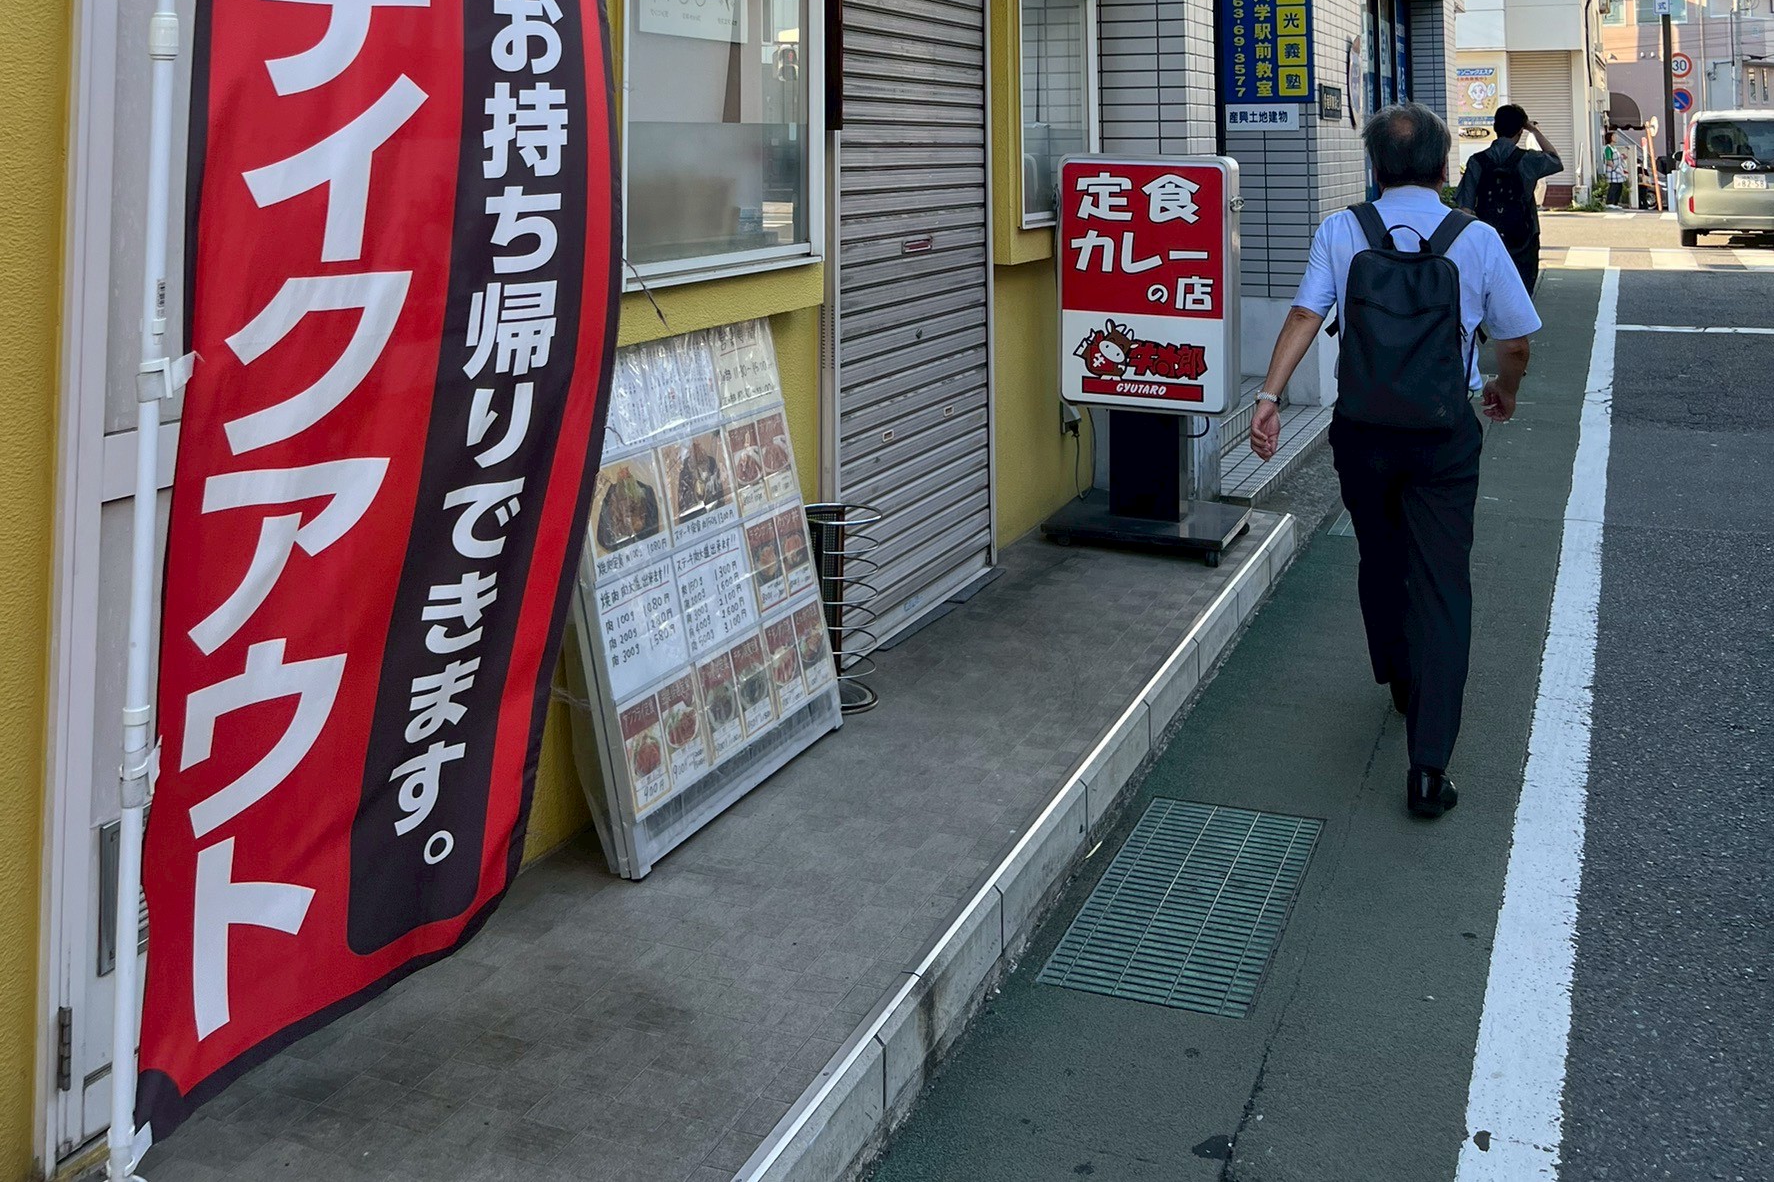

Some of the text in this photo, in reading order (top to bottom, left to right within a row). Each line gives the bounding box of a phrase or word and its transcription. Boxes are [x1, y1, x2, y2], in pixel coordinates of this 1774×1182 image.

[1672, 59, 1687, 72] 30
[1229, 110, 1289, 124] 産興土地建物
[1075, 171, 1202, 225] 定食
[1070, 229, 1209, 274] カレー
[1146, 276, 1214, 312] の店
[1127, 339, 1208, 380] 牛太郎
[1116, 383, 1167, 396] GYUTARO
